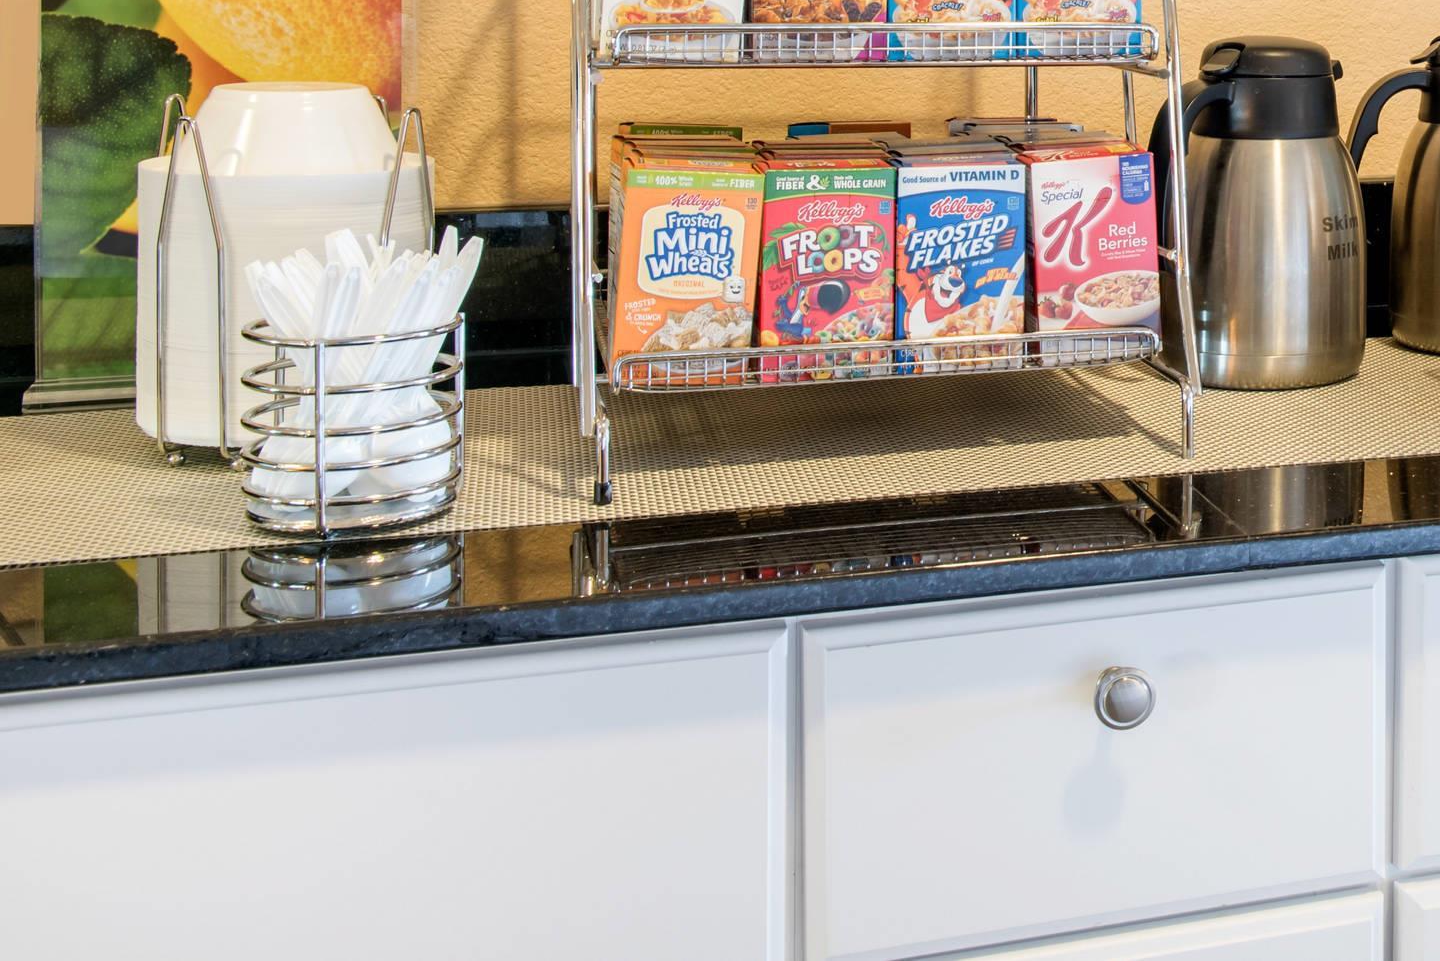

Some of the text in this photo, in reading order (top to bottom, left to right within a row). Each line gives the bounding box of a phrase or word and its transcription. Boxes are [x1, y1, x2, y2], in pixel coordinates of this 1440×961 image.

[776, 181, 805, 190] FIBER
[806, 174, 826, 191] &
[834, 179, 887, 189] WHOLE GRAIN
[949, 170, 1006, 182] VITAMIN
[1010, 170, 1020, 180] D
[671, 193, 721, 211] Kellogg's
[1040, 188, 1083, 205] Special
[799, 201, 864, 223] Kellogg's
[931, 197, 994, 219] Kellogg's
[668, 213, 720, 229] Frosted
[1041, 186, 1113, 267] K
[1109, 222, 1136, 237] Red
[656, 228, 729, 256] Mini
[782, 225, 875, 260] FROOT
[908, 215, 1009, 252] FROSTED
[1098, 235, 1148, 251] Berries
[910, 235, 996, 270] FLAKES
[1327, 241, 1358, 261] Milk
[648, 251, 730, 278] Wheats
[797, 249, 880, 275] LOOPS
